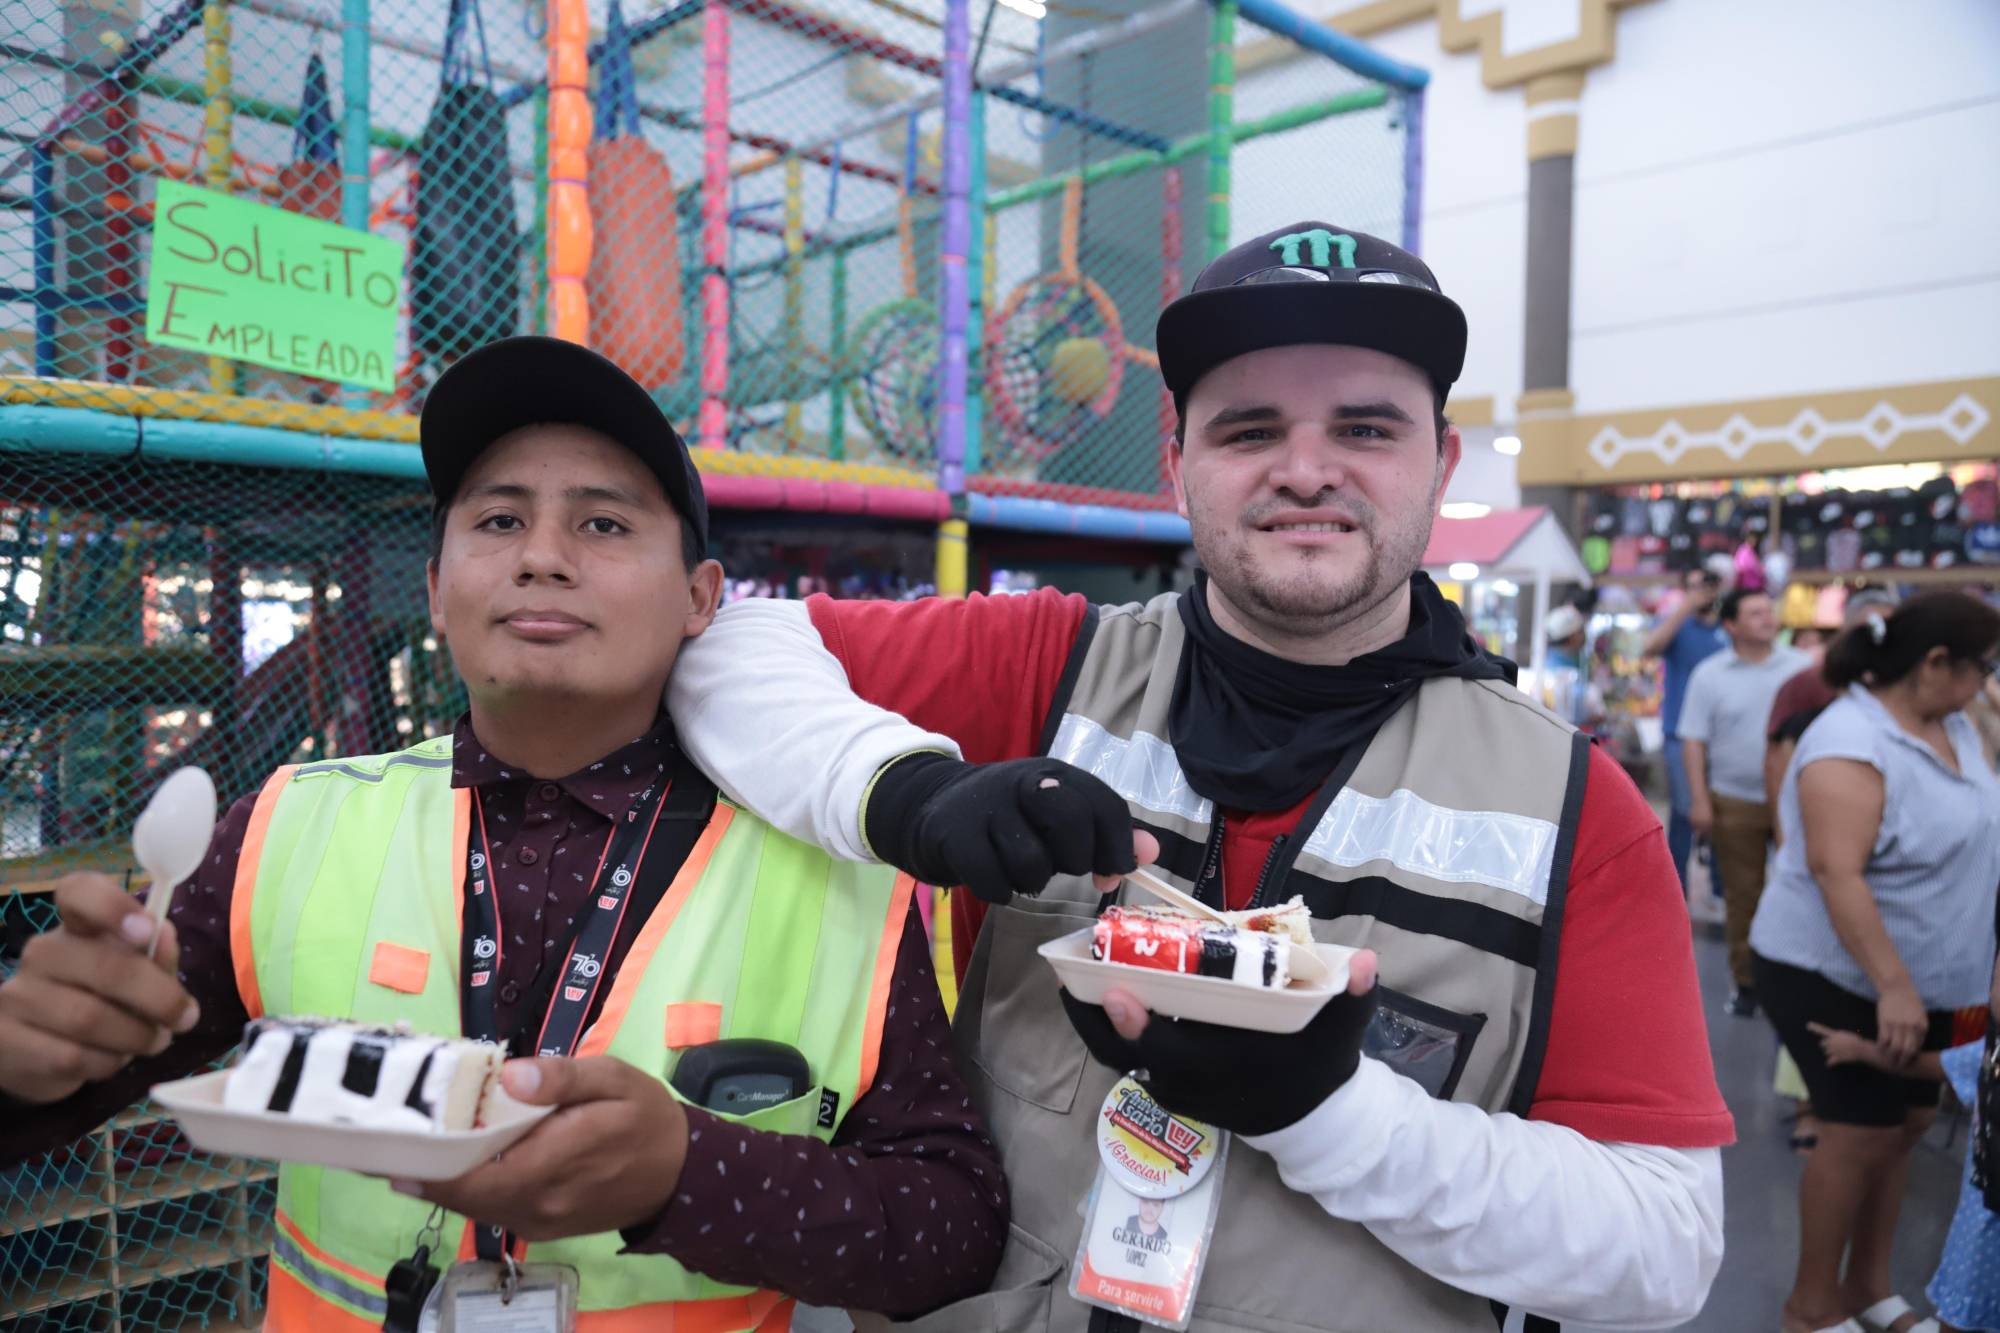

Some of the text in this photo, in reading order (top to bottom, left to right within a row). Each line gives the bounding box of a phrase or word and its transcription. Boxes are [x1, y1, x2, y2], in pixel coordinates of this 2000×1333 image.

[156, 281, 384, 380] EMPLEADA
[819, 1103, 832, 1123] 2
[1112, 1227, 1172, 1256] GERARDO
[1097, 1279, 1122, 1298] Para
